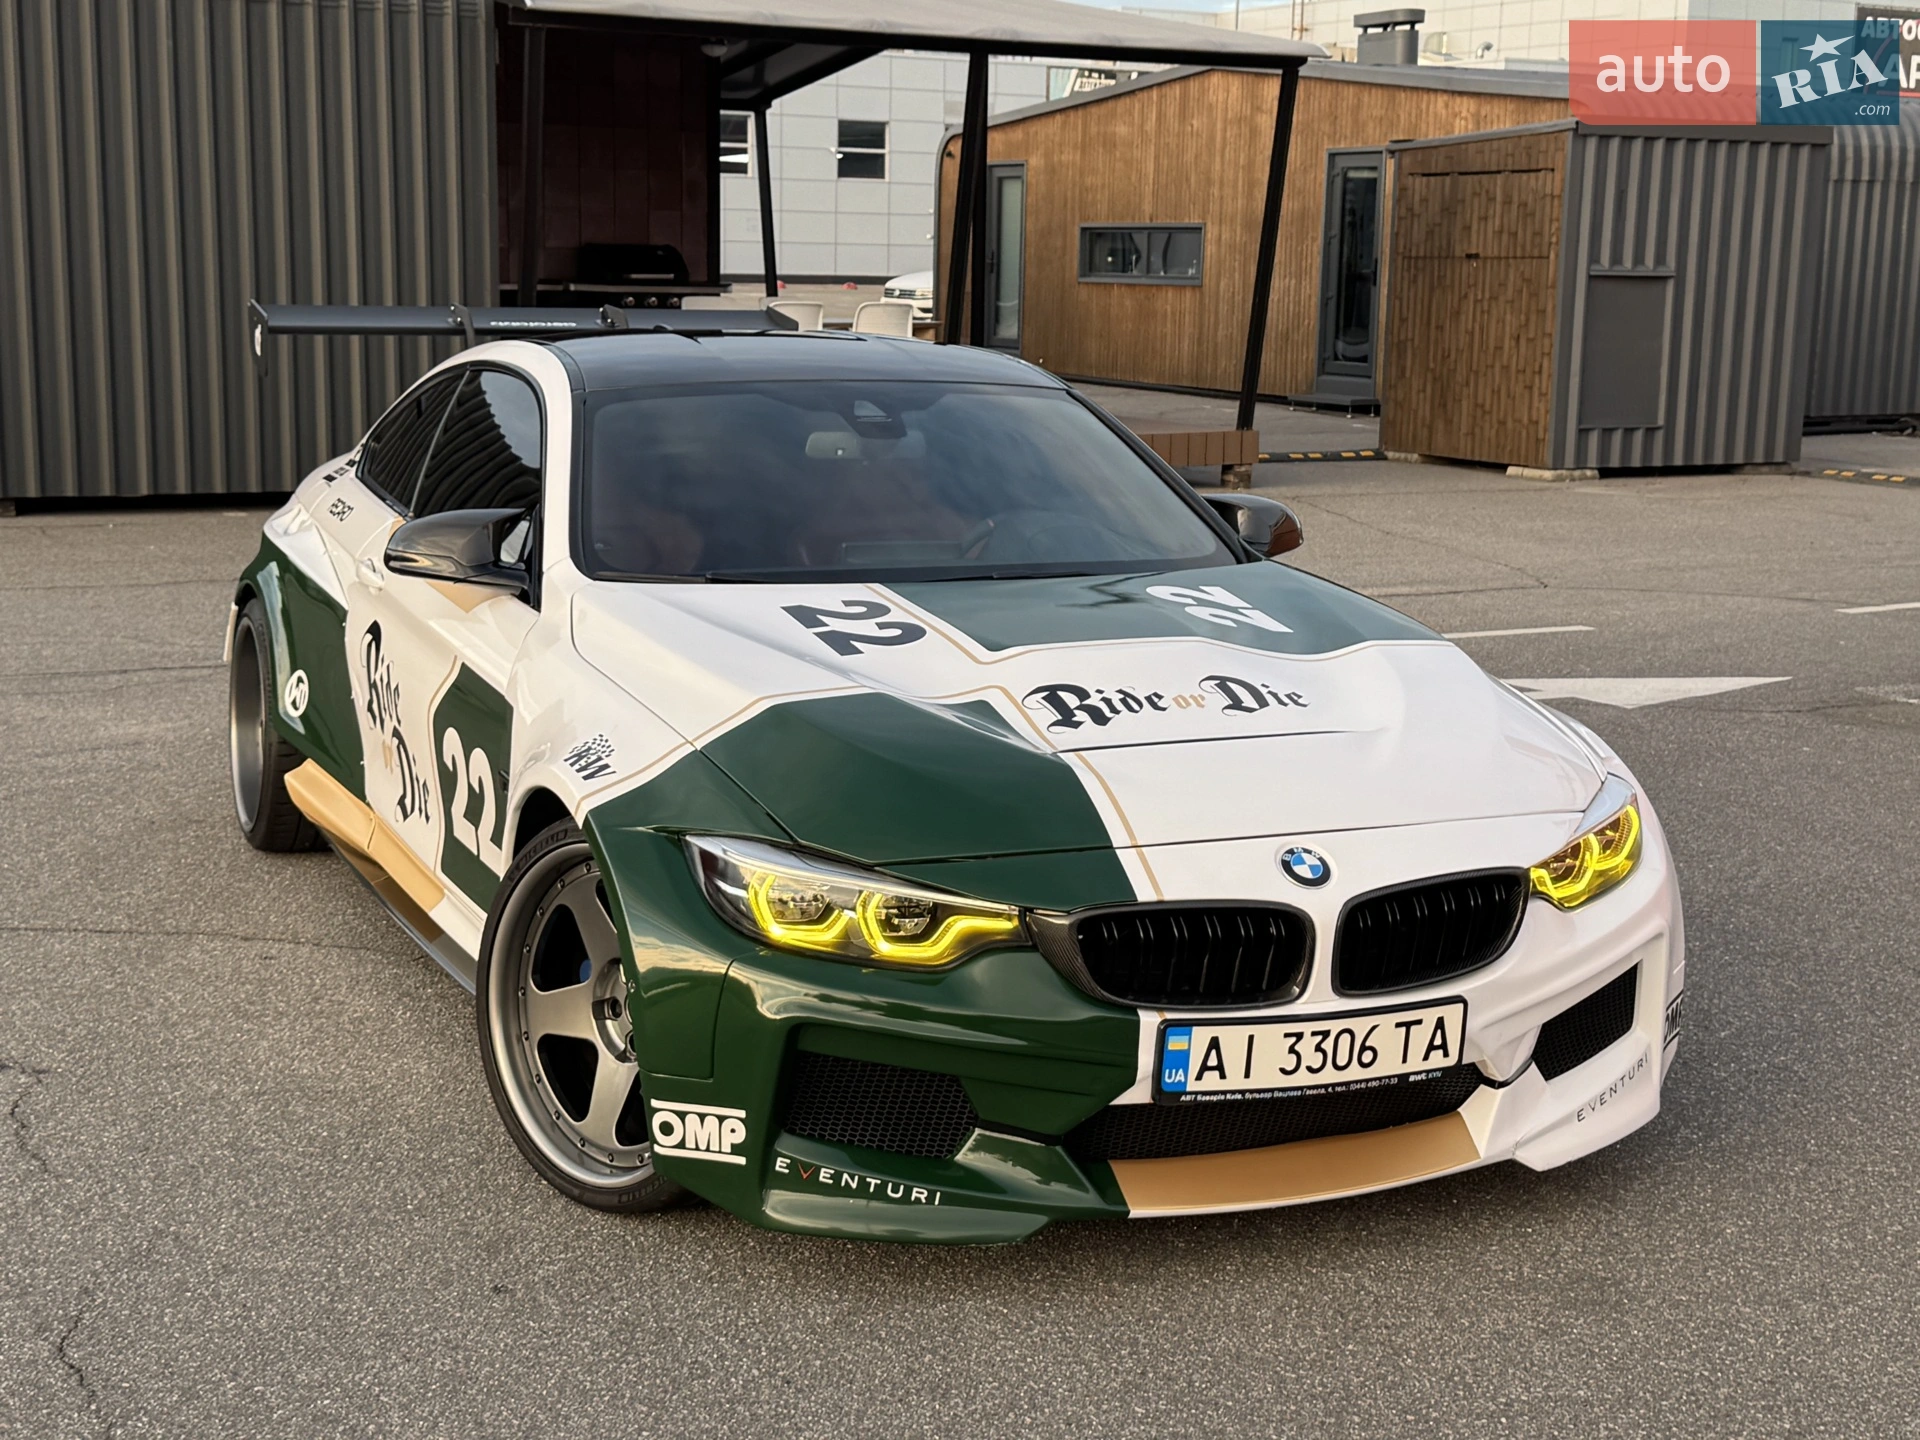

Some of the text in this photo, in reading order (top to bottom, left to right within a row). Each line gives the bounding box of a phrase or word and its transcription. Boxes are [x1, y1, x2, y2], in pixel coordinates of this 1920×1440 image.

[1861, 16, 1920, 40] АВТО
[780, 599, 927, 657] 22
[1146, 585, 1294, 633] 22
[360, 619, 401, 735] Ride
[1021, 675, 1312, 734] Ride or Die
[391, 724, 432, 825] Die
[443, 727, 503, 880] 22
[1282, 847, 1321, 861] BMW
[1164, 1016, 1449, 1083] UA AI 3306 TA
[1576, 1052, 1649, 1123] EVENTURI
[651, 1110, 747, 1154] OMP
[774, 1156, 941, 1206] EVENTURI
